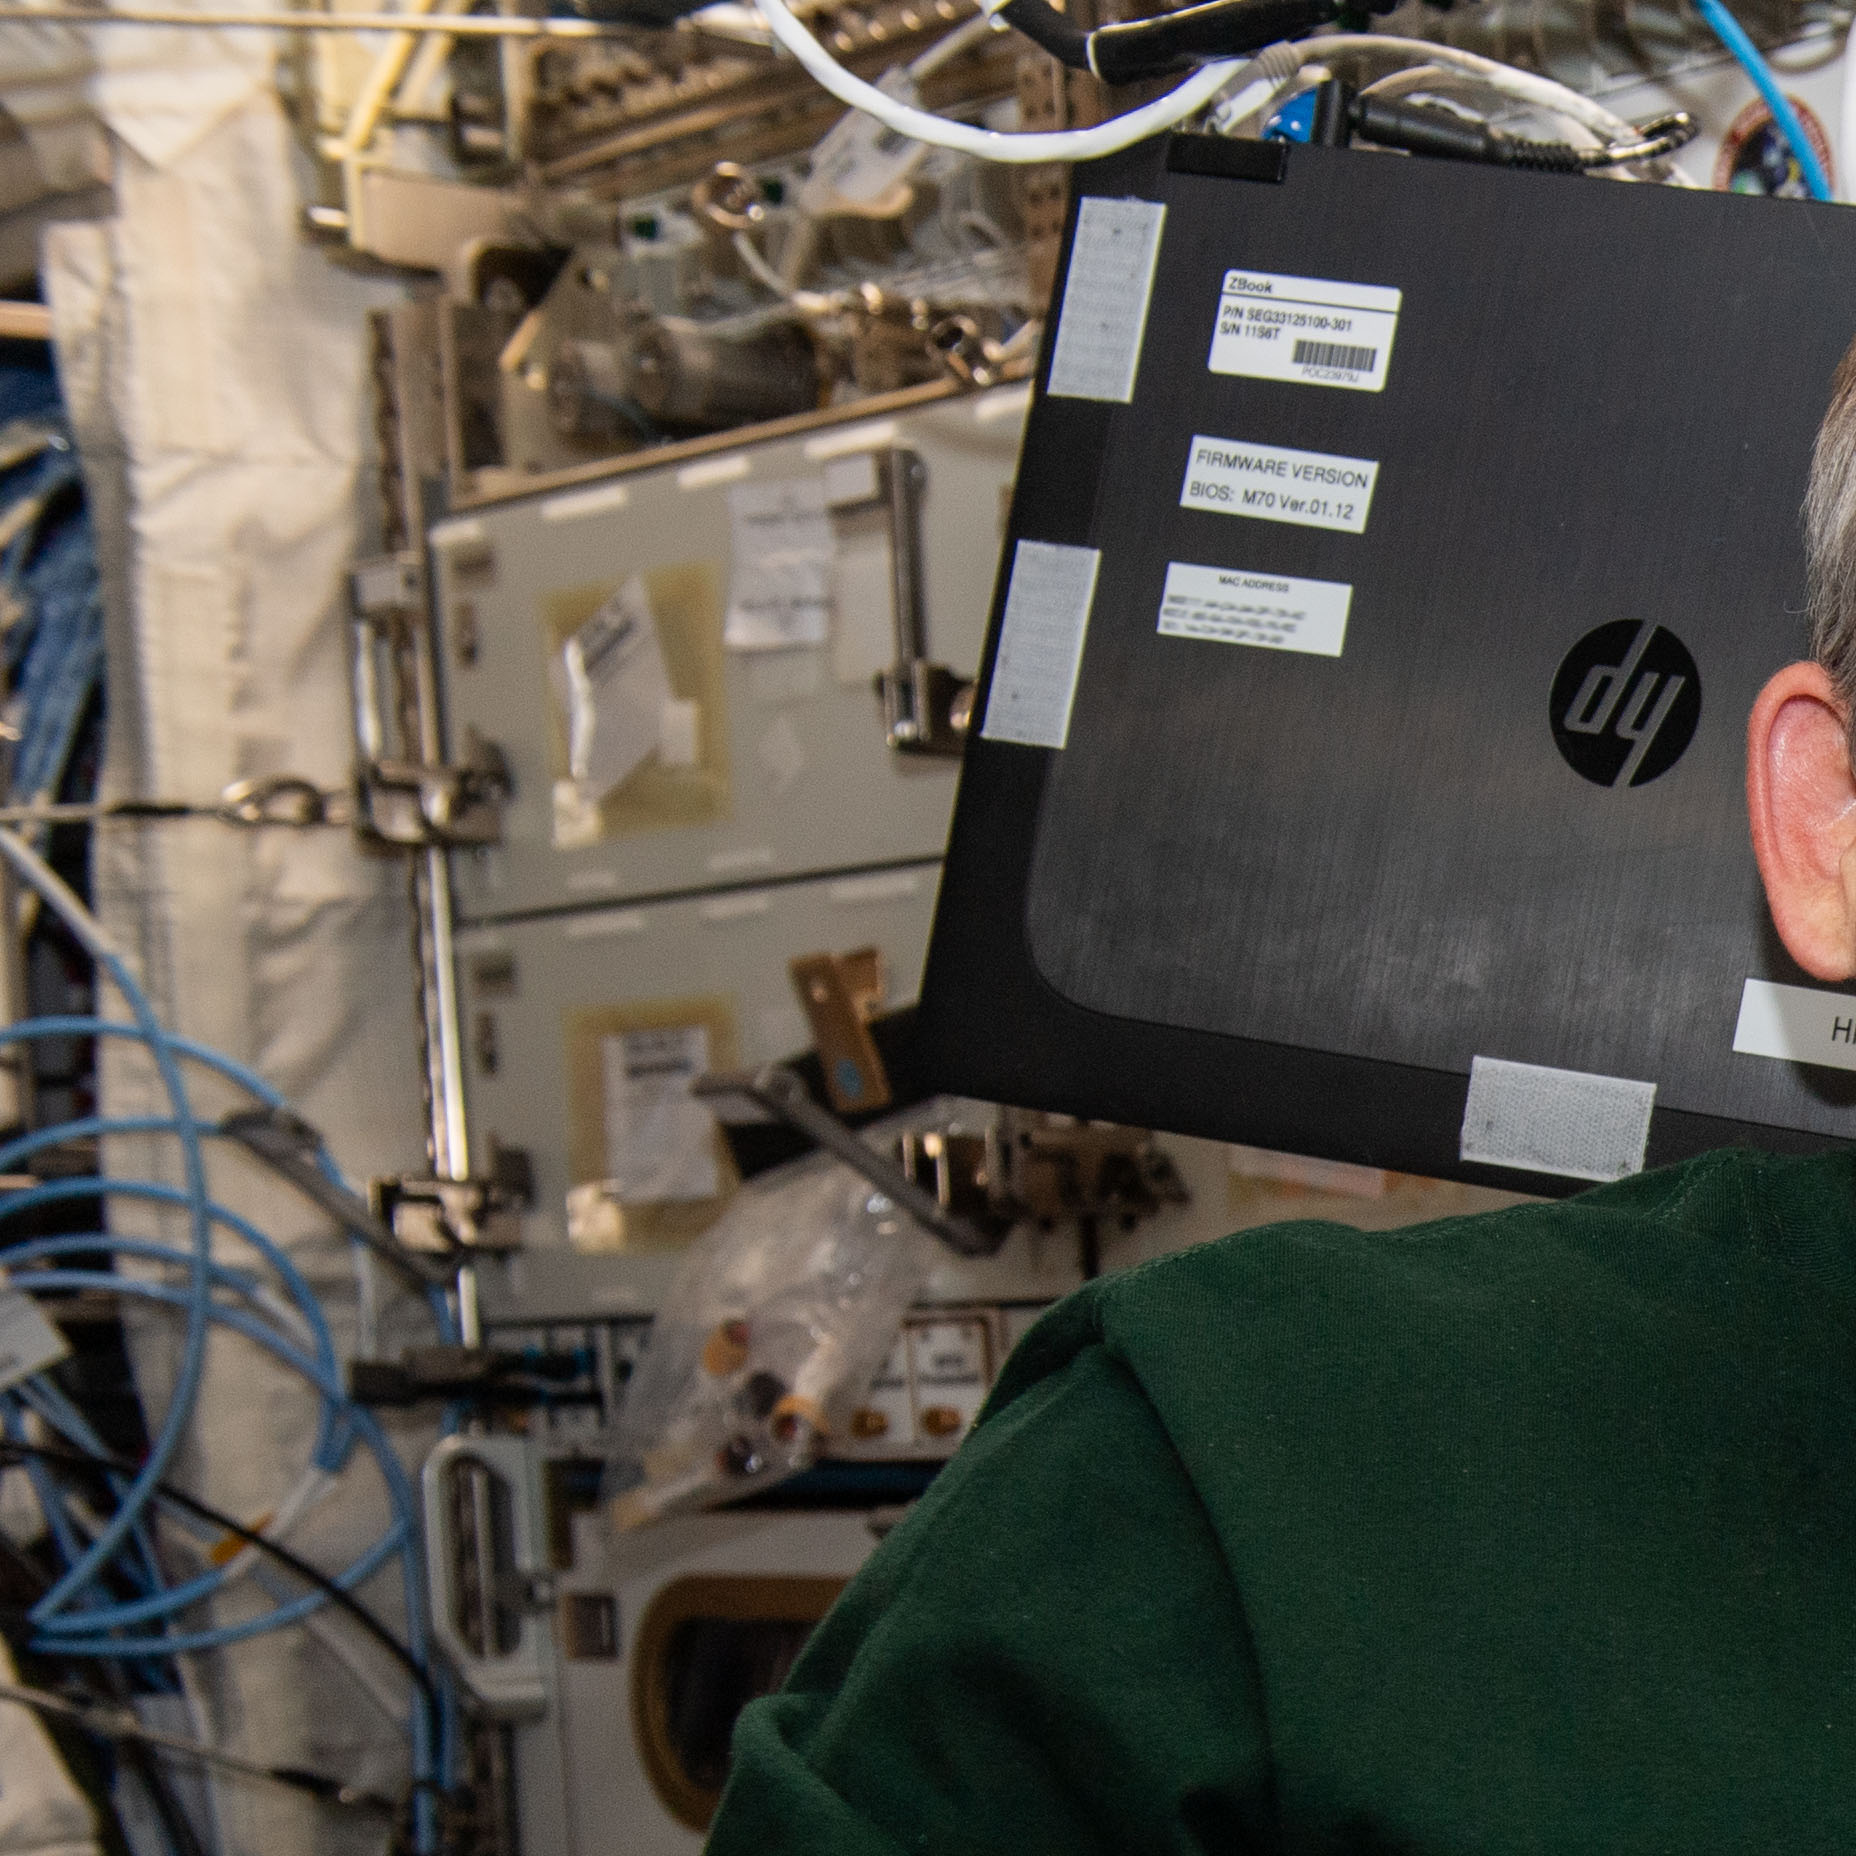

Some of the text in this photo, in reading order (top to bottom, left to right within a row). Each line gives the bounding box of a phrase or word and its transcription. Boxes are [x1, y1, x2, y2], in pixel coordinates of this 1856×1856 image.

[1228, 277, 1272, 294] ZBook
[1224, 305, 1243, 320] P/N
[1220, 323, 1240, 337] S/N
[1196, 450, 1369, 488] FIRMWARE VERSION
[1189, 480, 1354, 520] BIOS: M70 Ver.01.12
[1219, 575, 1290, 593] MAC ADDRESS
